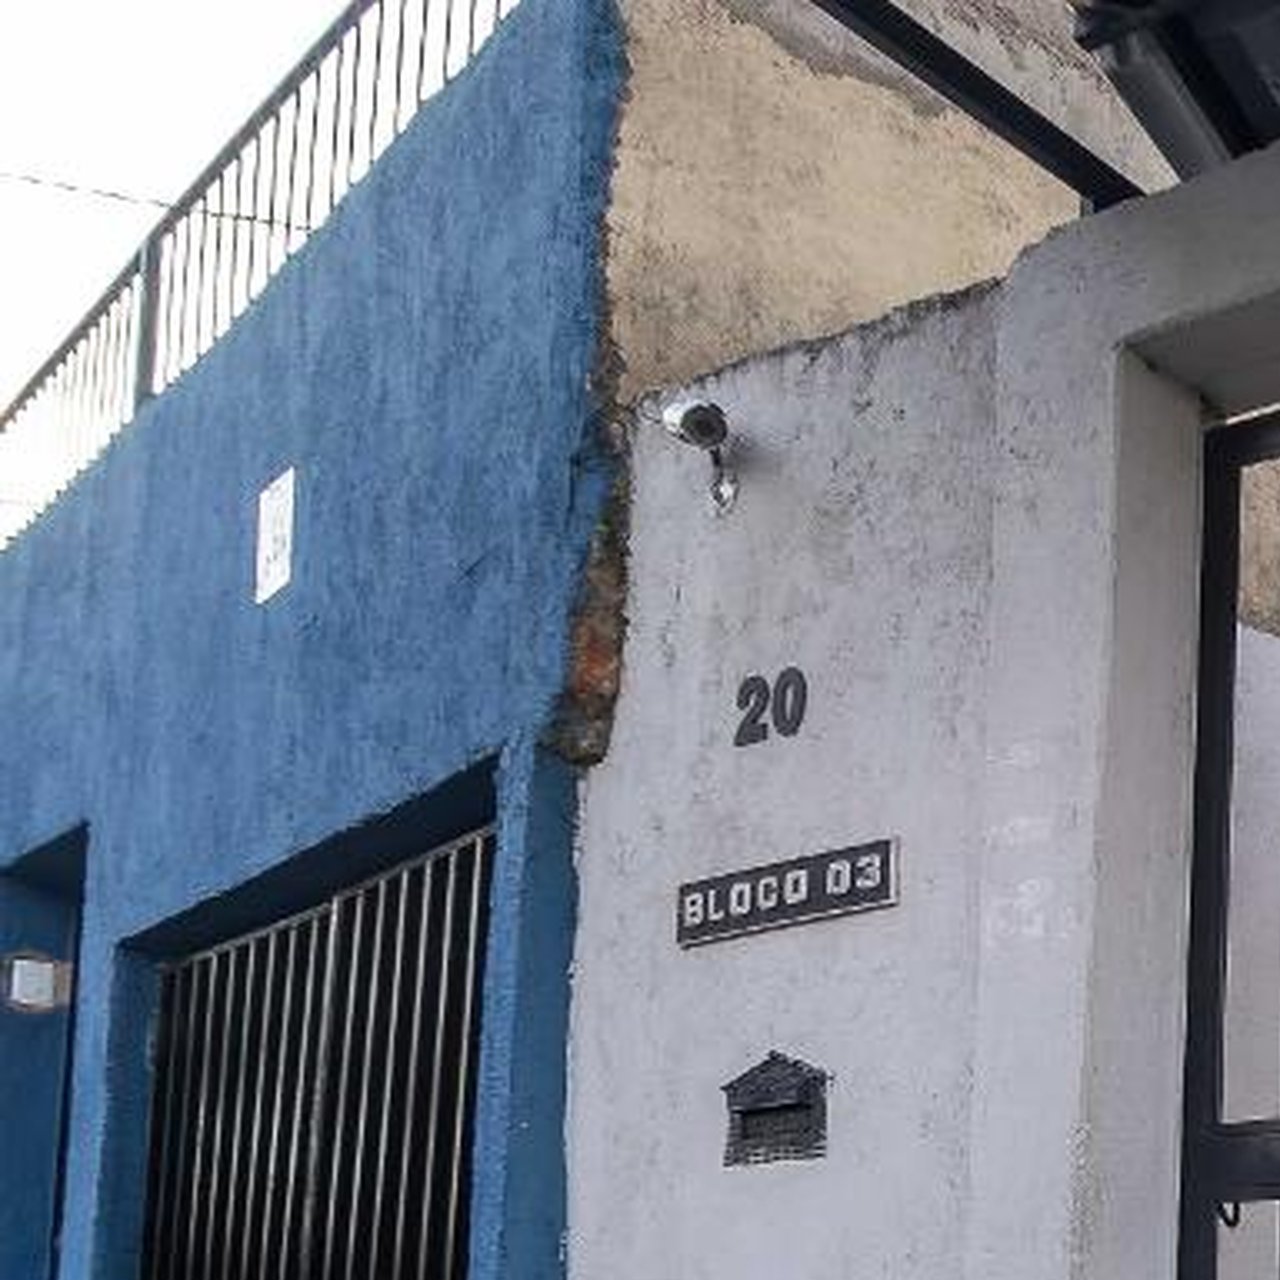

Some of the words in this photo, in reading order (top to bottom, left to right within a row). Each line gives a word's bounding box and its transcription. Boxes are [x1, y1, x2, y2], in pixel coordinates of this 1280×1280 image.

[733, 665, 808, 748] 20
[684, 869, 808, 927] BLOCO
[826, 853, 881, 895] 03
